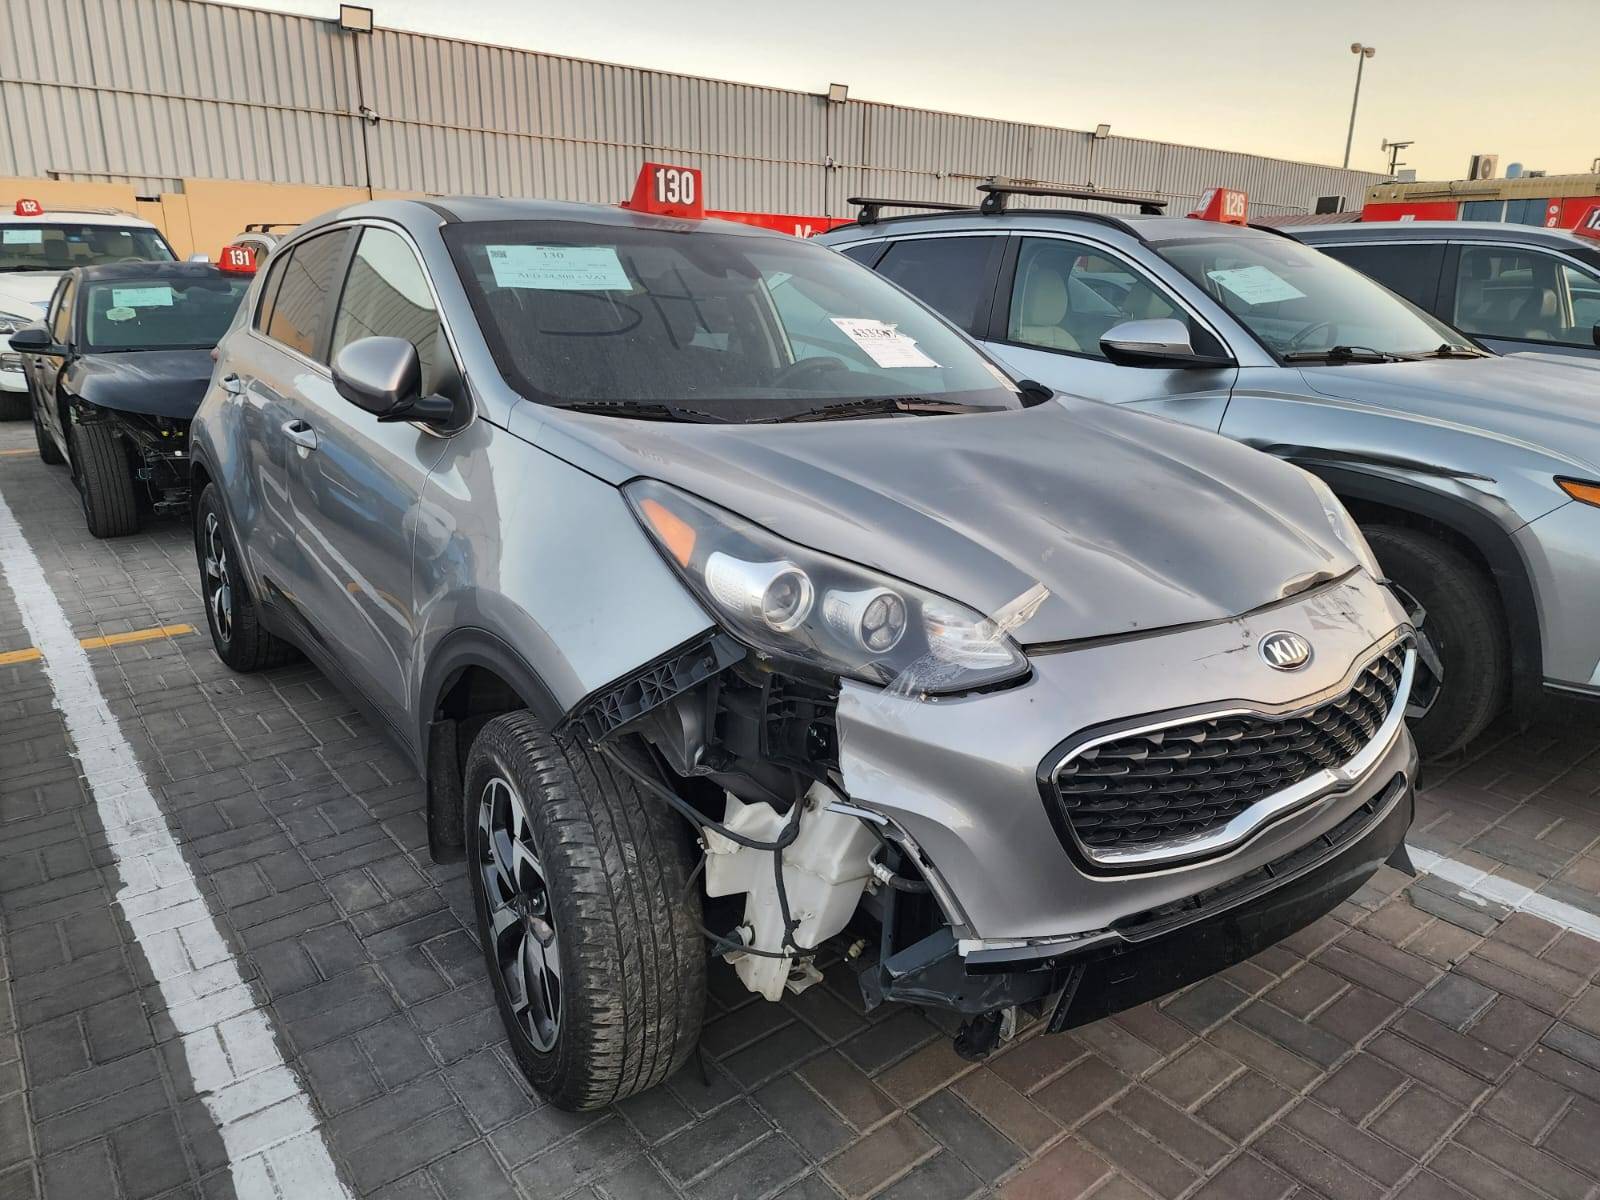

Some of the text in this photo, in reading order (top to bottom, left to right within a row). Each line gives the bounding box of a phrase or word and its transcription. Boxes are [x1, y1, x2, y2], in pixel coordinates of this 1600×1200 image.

[656, 168, 694, 205] 130
[20, 200, 39, 213] 132
[1225, 191, 1245, 217] 126
[230, 249, 251, 266] 131
[542, 251, 565, 260] 130
[1265, 637, 1309, 664] KIA
